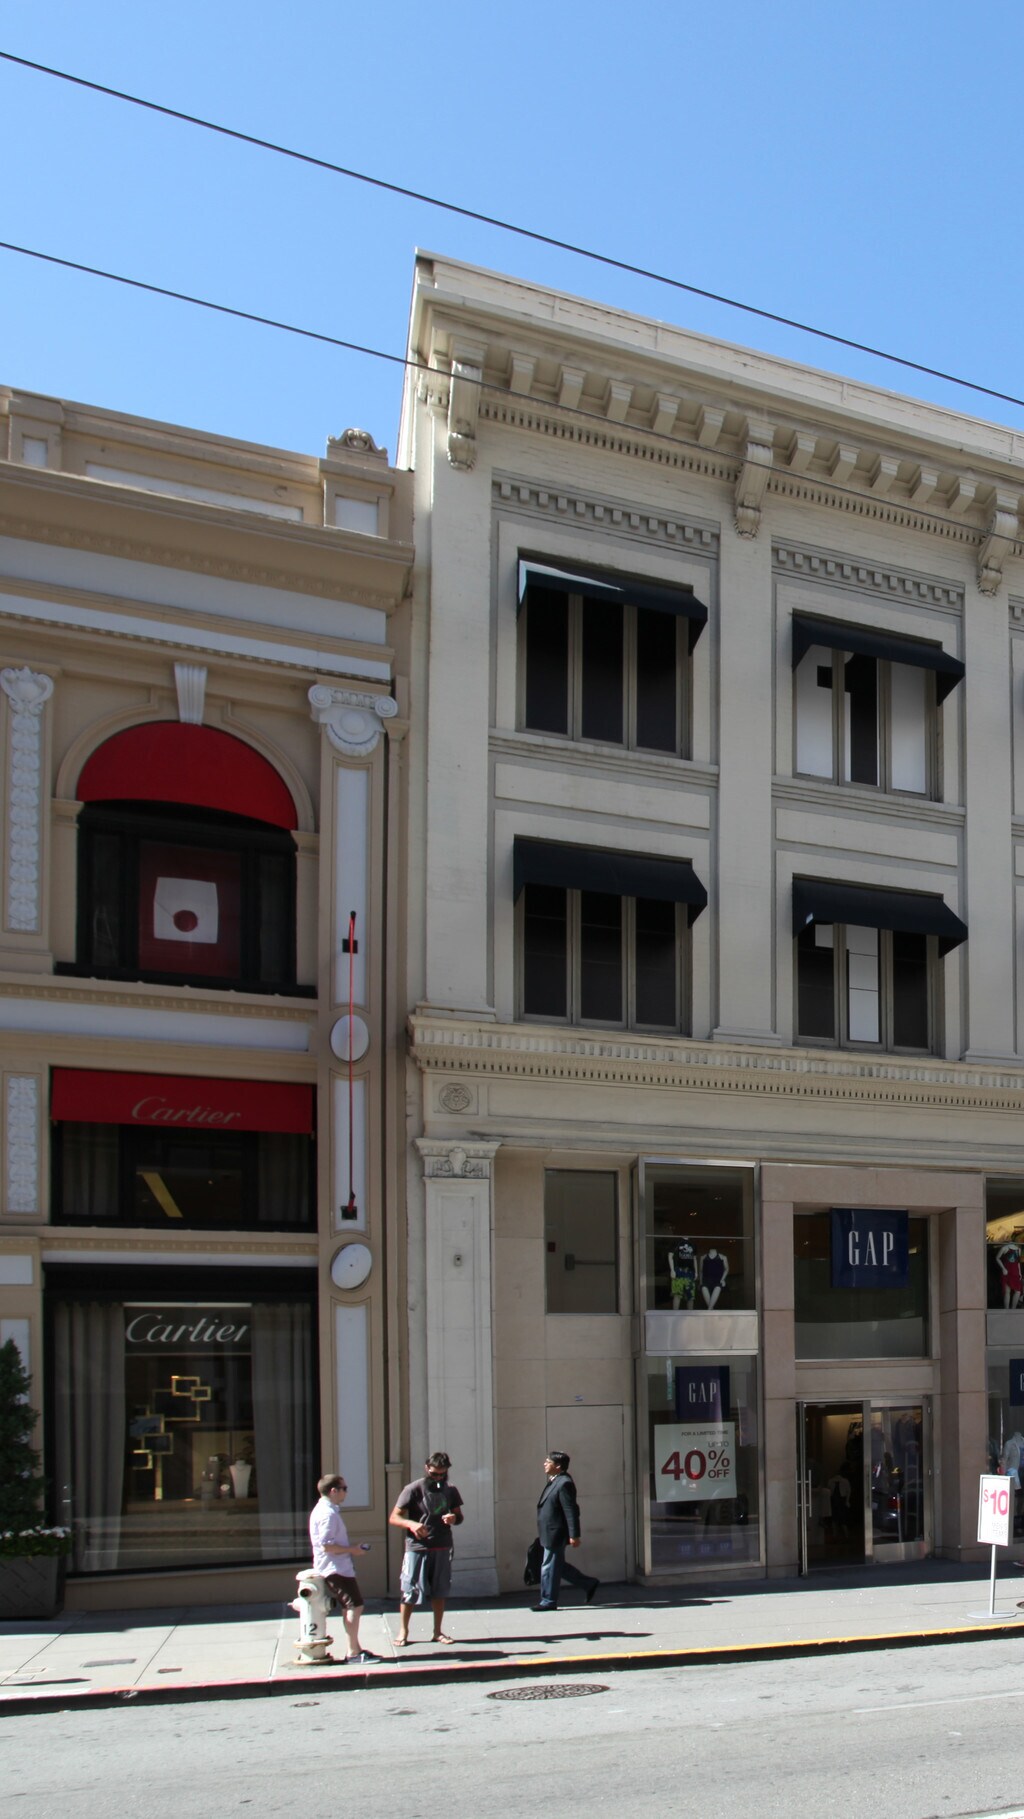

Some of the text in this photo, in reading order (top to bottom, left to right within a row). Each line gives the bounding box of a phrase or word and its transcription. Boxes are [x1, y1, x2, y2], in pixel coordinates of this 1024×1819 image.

[131, 1096, 243, 1125] Cartier
[848, 1231, 895, 1268] GAP
[125, 1313, 252, 1343] Cartier
[688, 1382, 717, 1403] GAP
[661, 1449, 730, 1481] 40% OFF
[304, 1623, 318, 1636] 12
